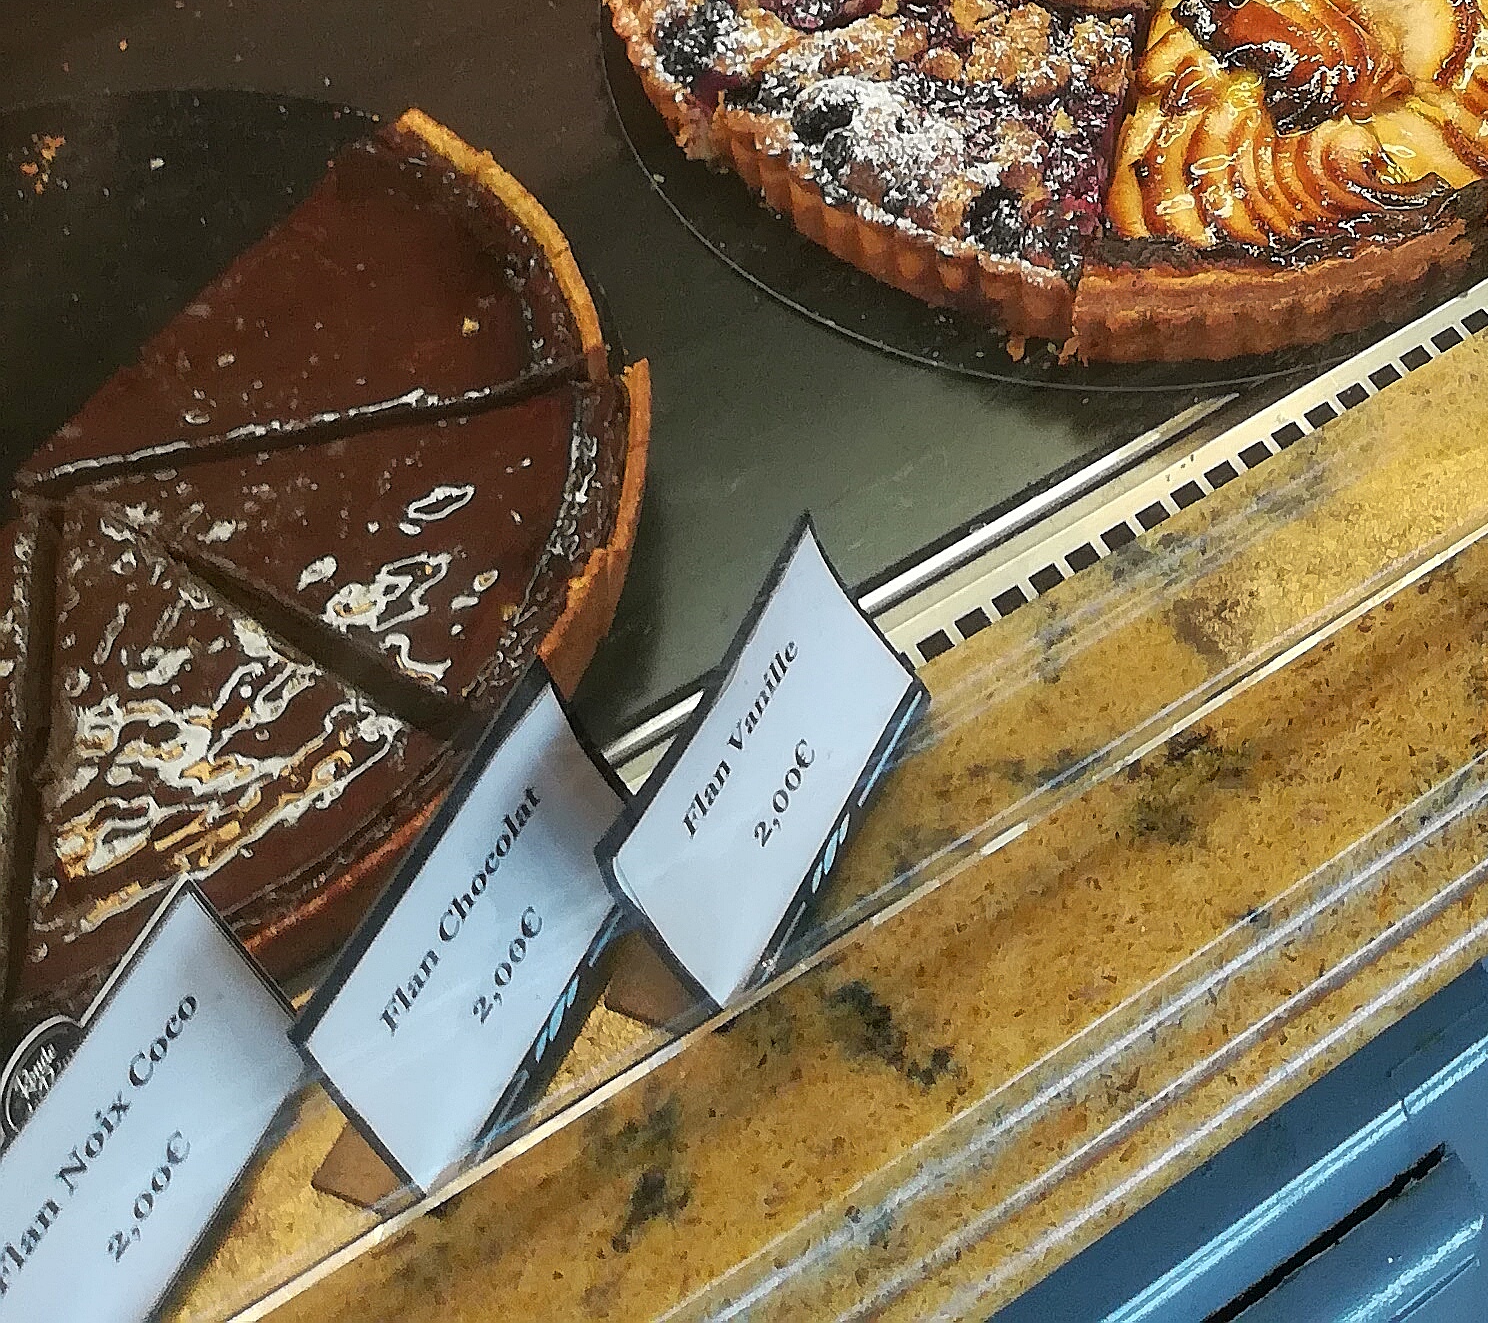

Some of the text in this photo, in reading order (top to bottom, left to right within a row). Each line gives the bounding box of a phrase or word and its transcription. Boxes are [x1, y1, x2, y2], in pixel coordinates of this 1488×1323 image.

[682, 639, 800, 840] Flan Vanille
[753, 738, 816, 847] 2,00€
[379, 785, 543, 1038] Flan Chocolat
[470, 905, 545, 1025] 2,00€
[55, 1091, 131, 1195] Noix
[129, 993, 199, 1087] Coco
[107, 1129, 192, 1262] 2,00€
